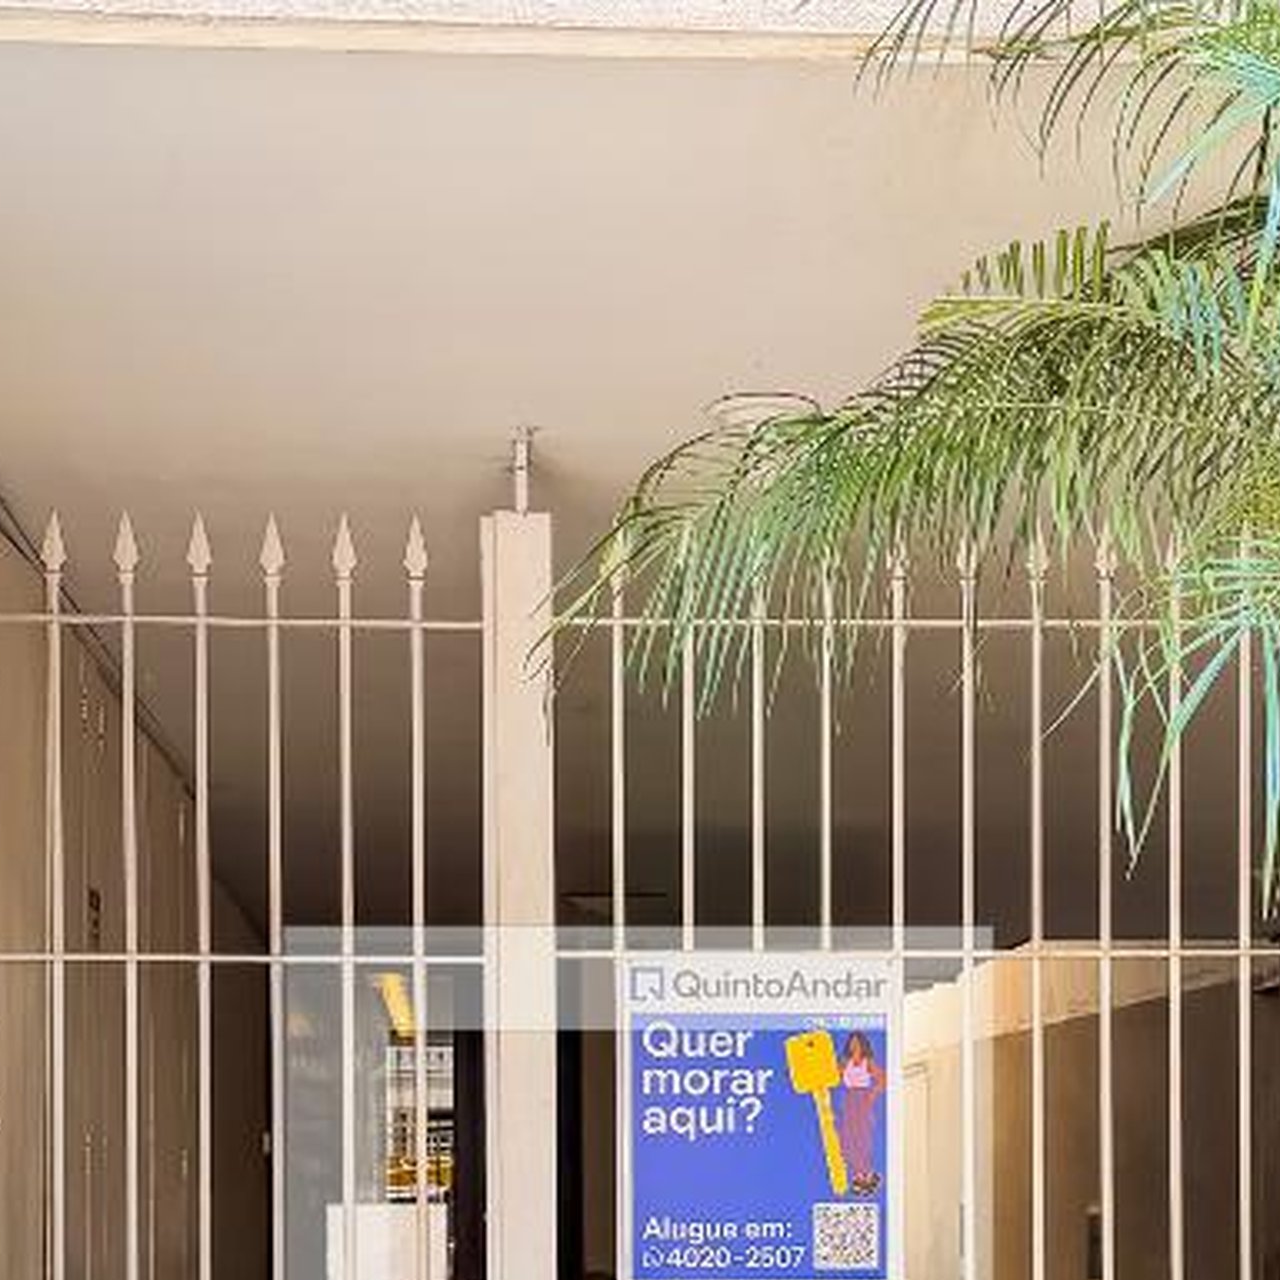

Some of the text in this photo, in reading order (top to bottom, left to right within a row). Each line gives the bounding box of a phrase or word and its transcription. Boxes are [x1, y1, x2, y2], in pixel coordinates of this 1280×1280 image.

[672, 969, 887, 999] QuintoAndar
[641, 1020, 753, 1058] Quer
[641, 1067, 774, 1095] morar
[641, 1097, 763, 1141] aqui?
[641, 1217, 793, 1244] Alugue em:
[665, 1245, 807, 1269] 4020-2507
